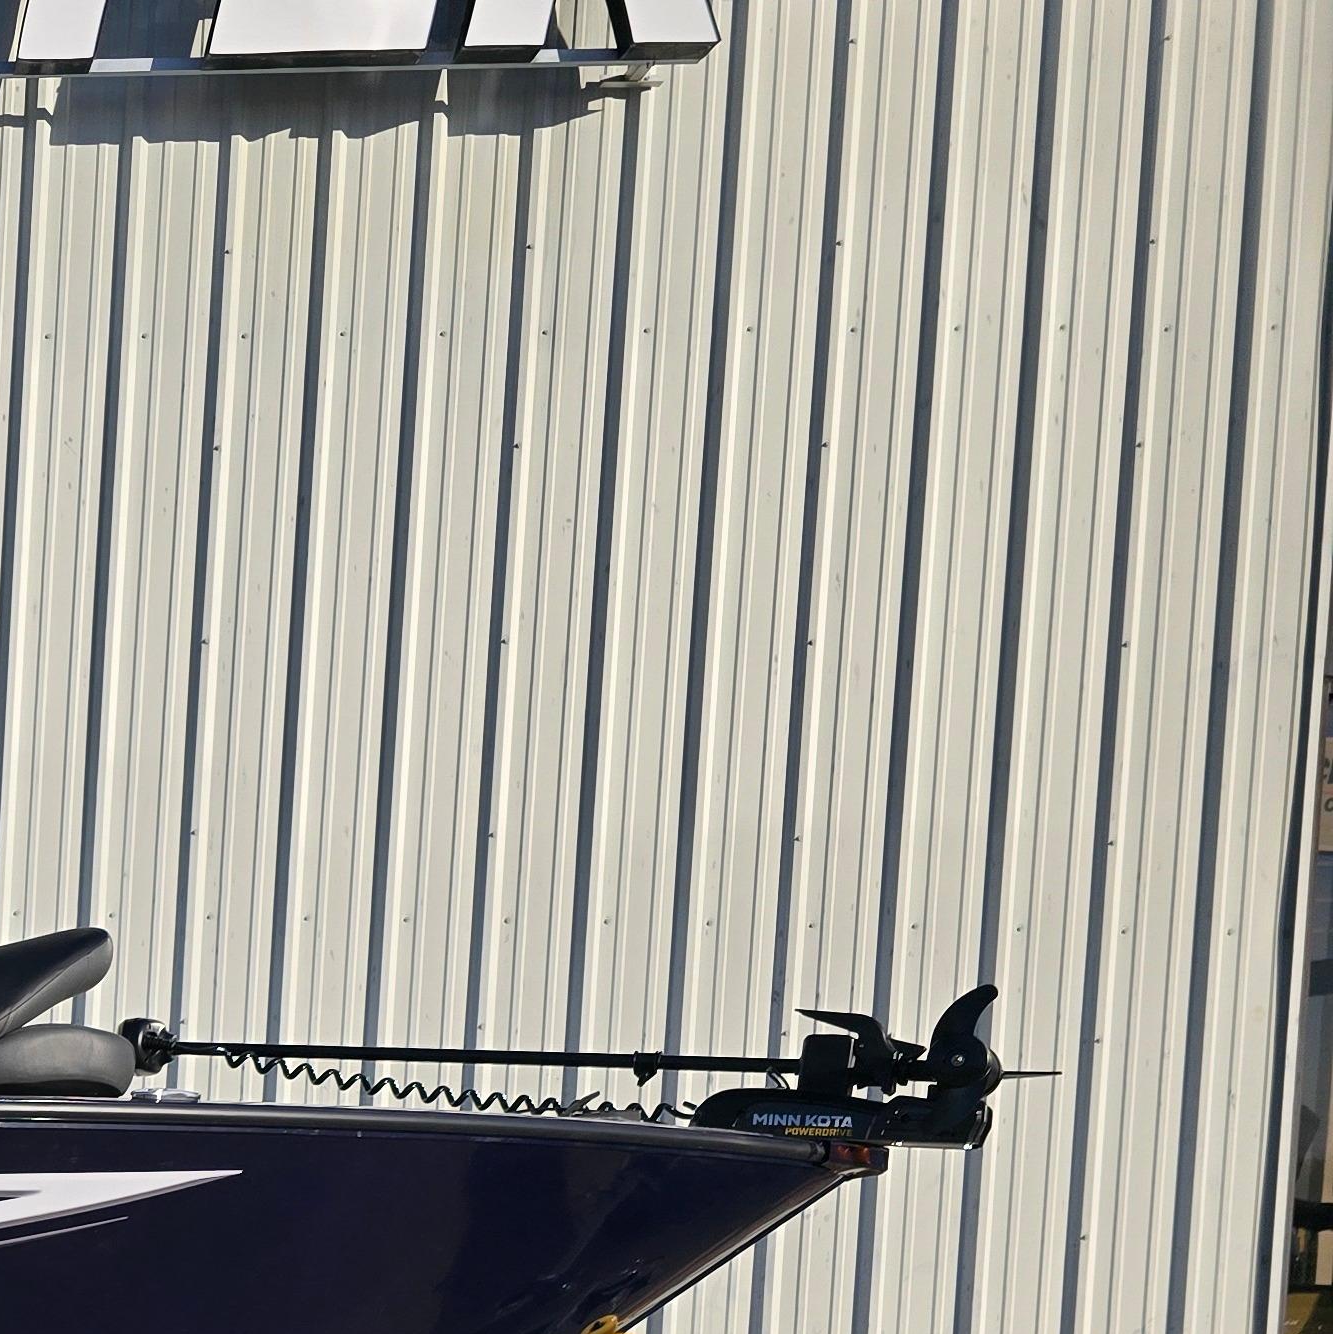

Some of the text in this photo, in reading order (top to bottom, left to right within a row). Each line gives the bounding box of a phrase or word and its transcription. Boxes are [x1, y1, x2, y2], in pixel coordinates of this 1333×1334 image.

[753, 1113, 853, 1128] MINN KOTA
[785, 1126, 853, 1137] POWERDRIVE
